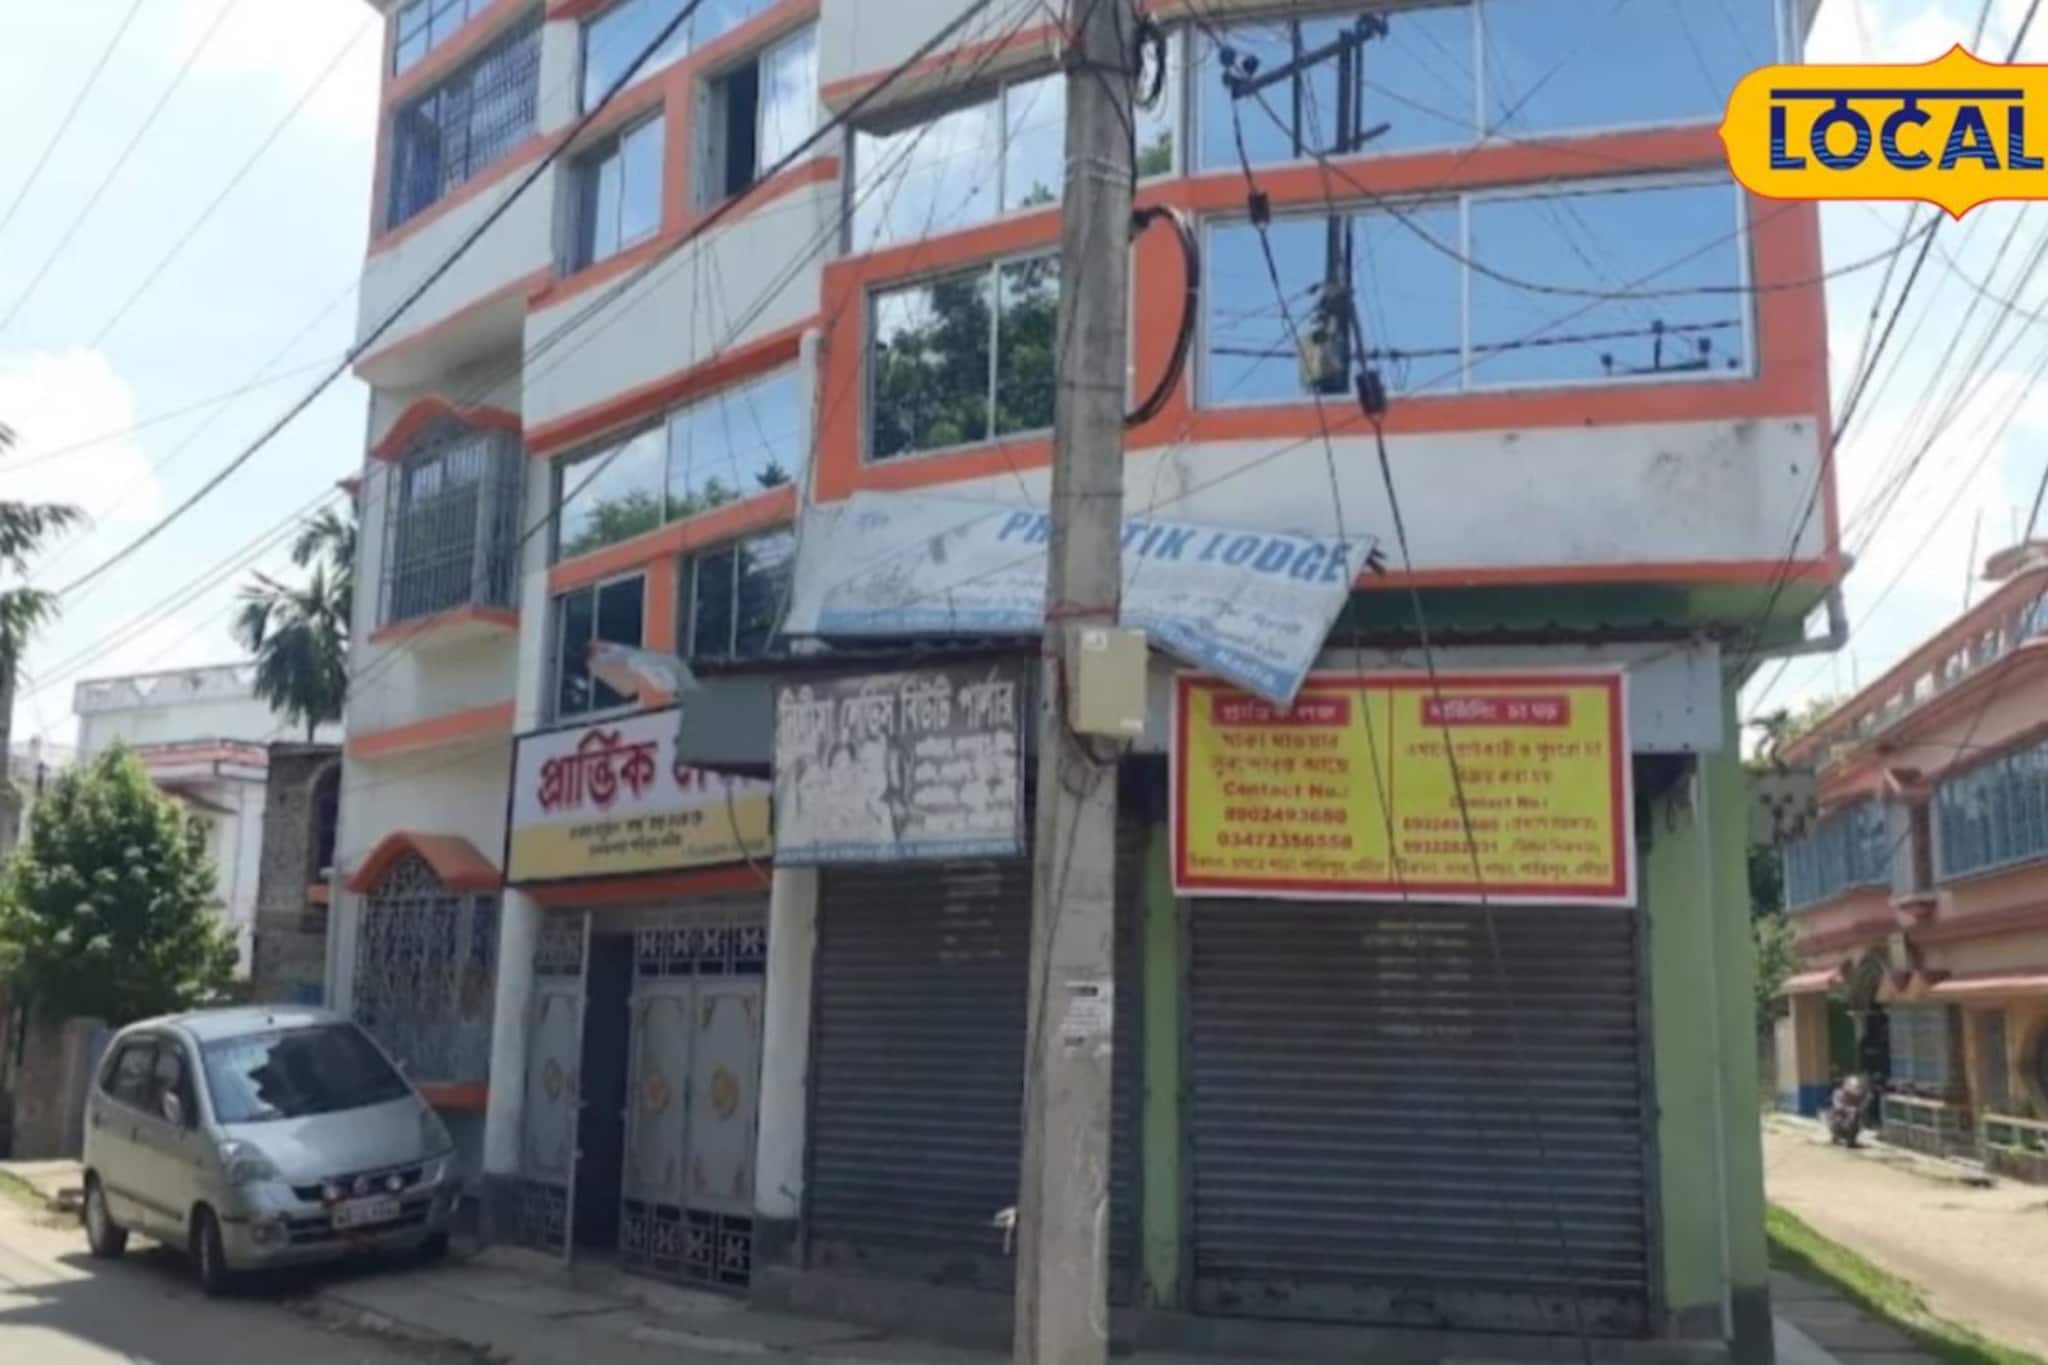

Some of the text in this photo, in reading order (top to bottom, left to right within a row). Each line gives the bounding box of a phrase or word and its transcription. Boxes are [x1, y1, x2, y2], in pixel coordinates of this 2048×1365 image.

[998, 510, 1353, 583] PRTIK LODGE
[1223, 780, 1302, 798] Contact
